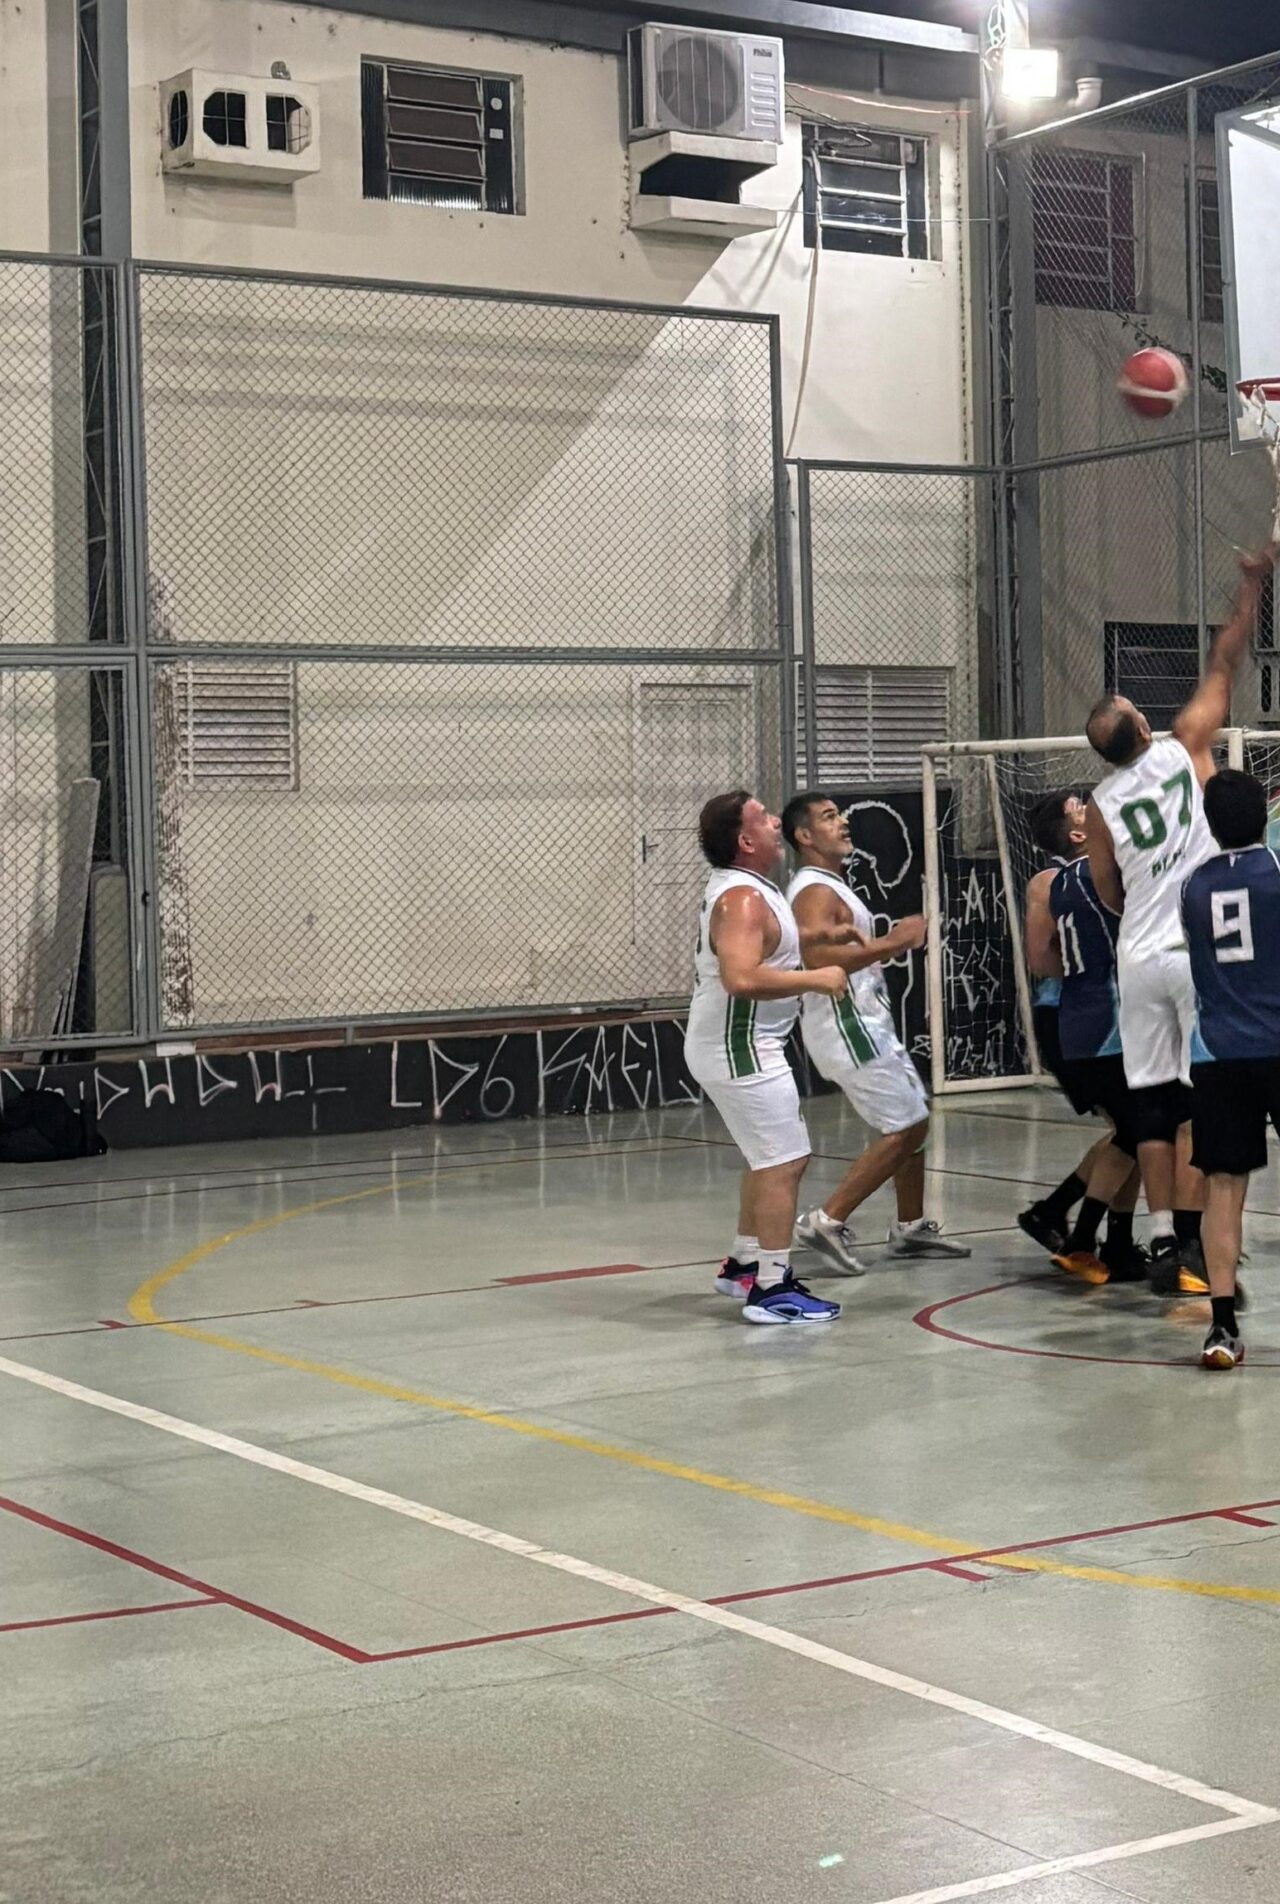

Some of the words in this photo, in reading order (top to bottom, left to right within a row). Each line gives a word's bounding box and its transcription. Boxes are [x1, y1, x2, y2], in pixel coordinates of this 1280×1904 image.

[1120, 768, 1192, 849] 07
[1057, 911, 1086, 977] 11
[1211, 888, 1254, 964] 9
